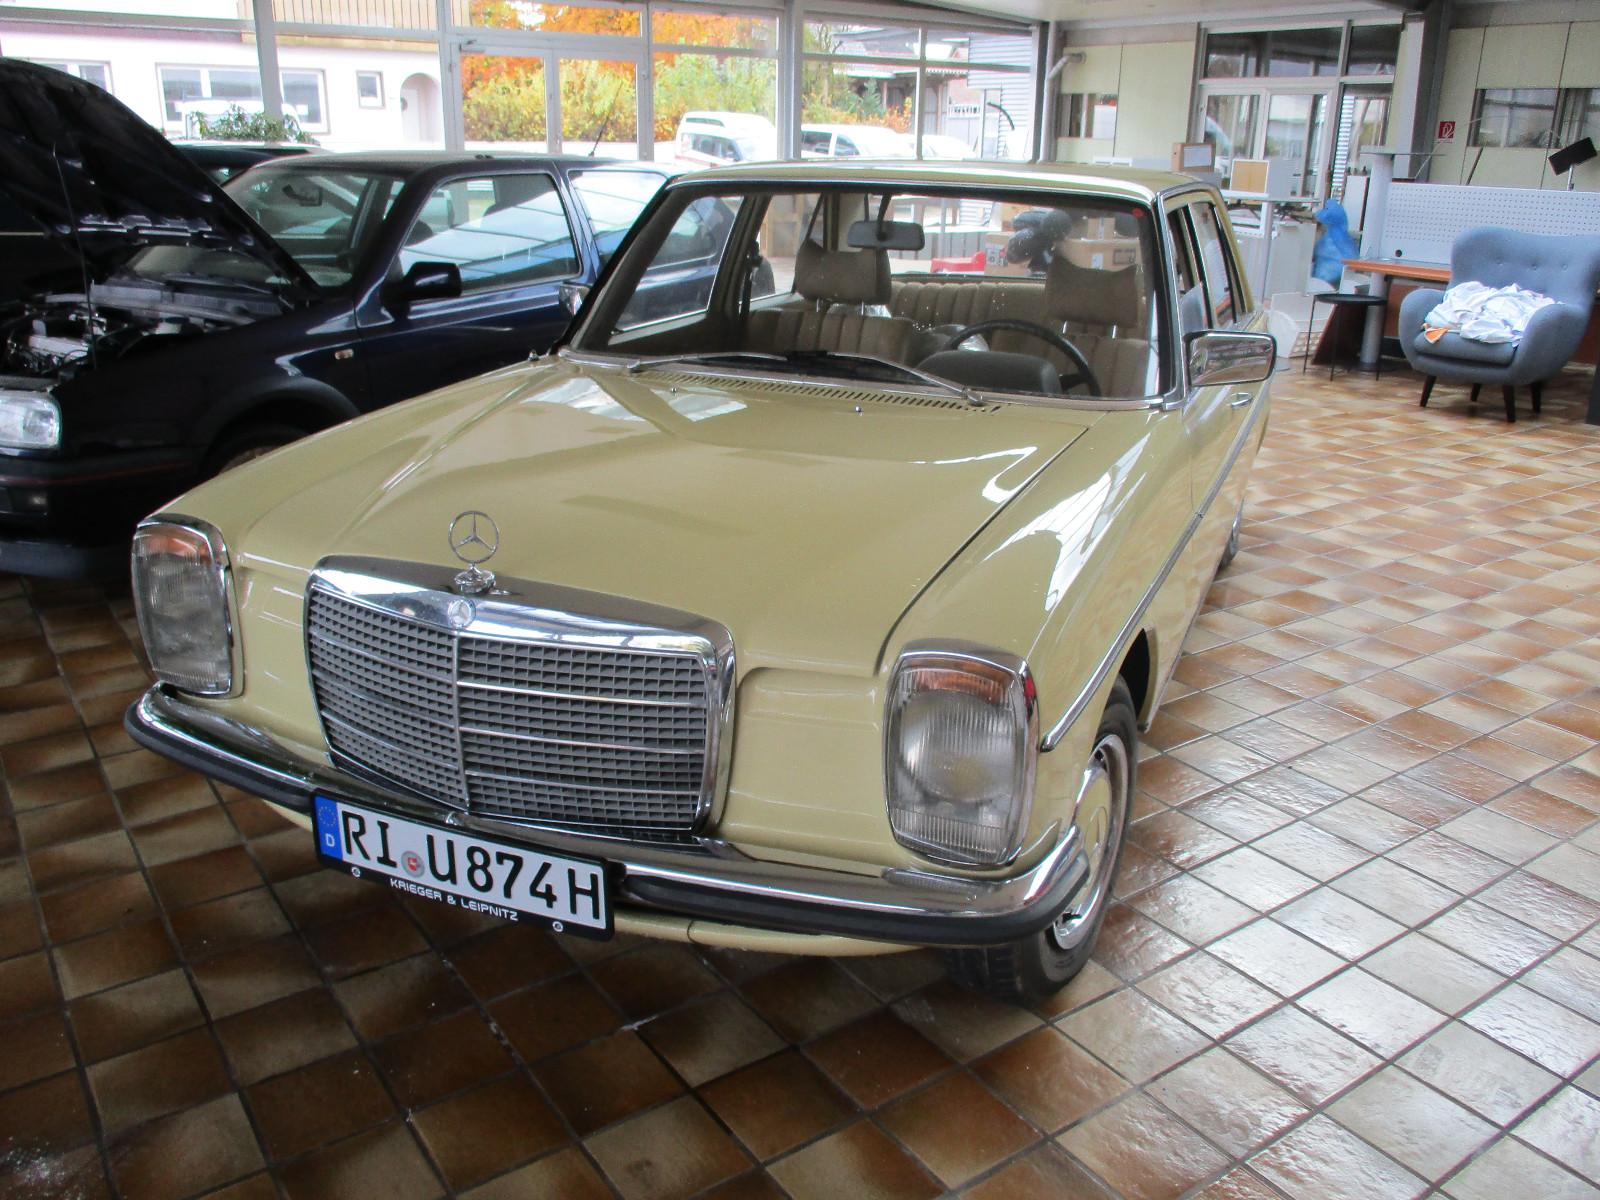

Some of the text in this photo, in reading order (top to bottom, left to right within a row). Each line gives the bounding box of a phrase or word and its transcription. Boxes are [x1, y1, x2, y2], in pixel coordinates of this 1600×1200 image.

[326, 833, 335, 848] D
[341, 810, 397, 868] RI
[390, 878, 519, 921] KRIEGER & LEIPNITZ
